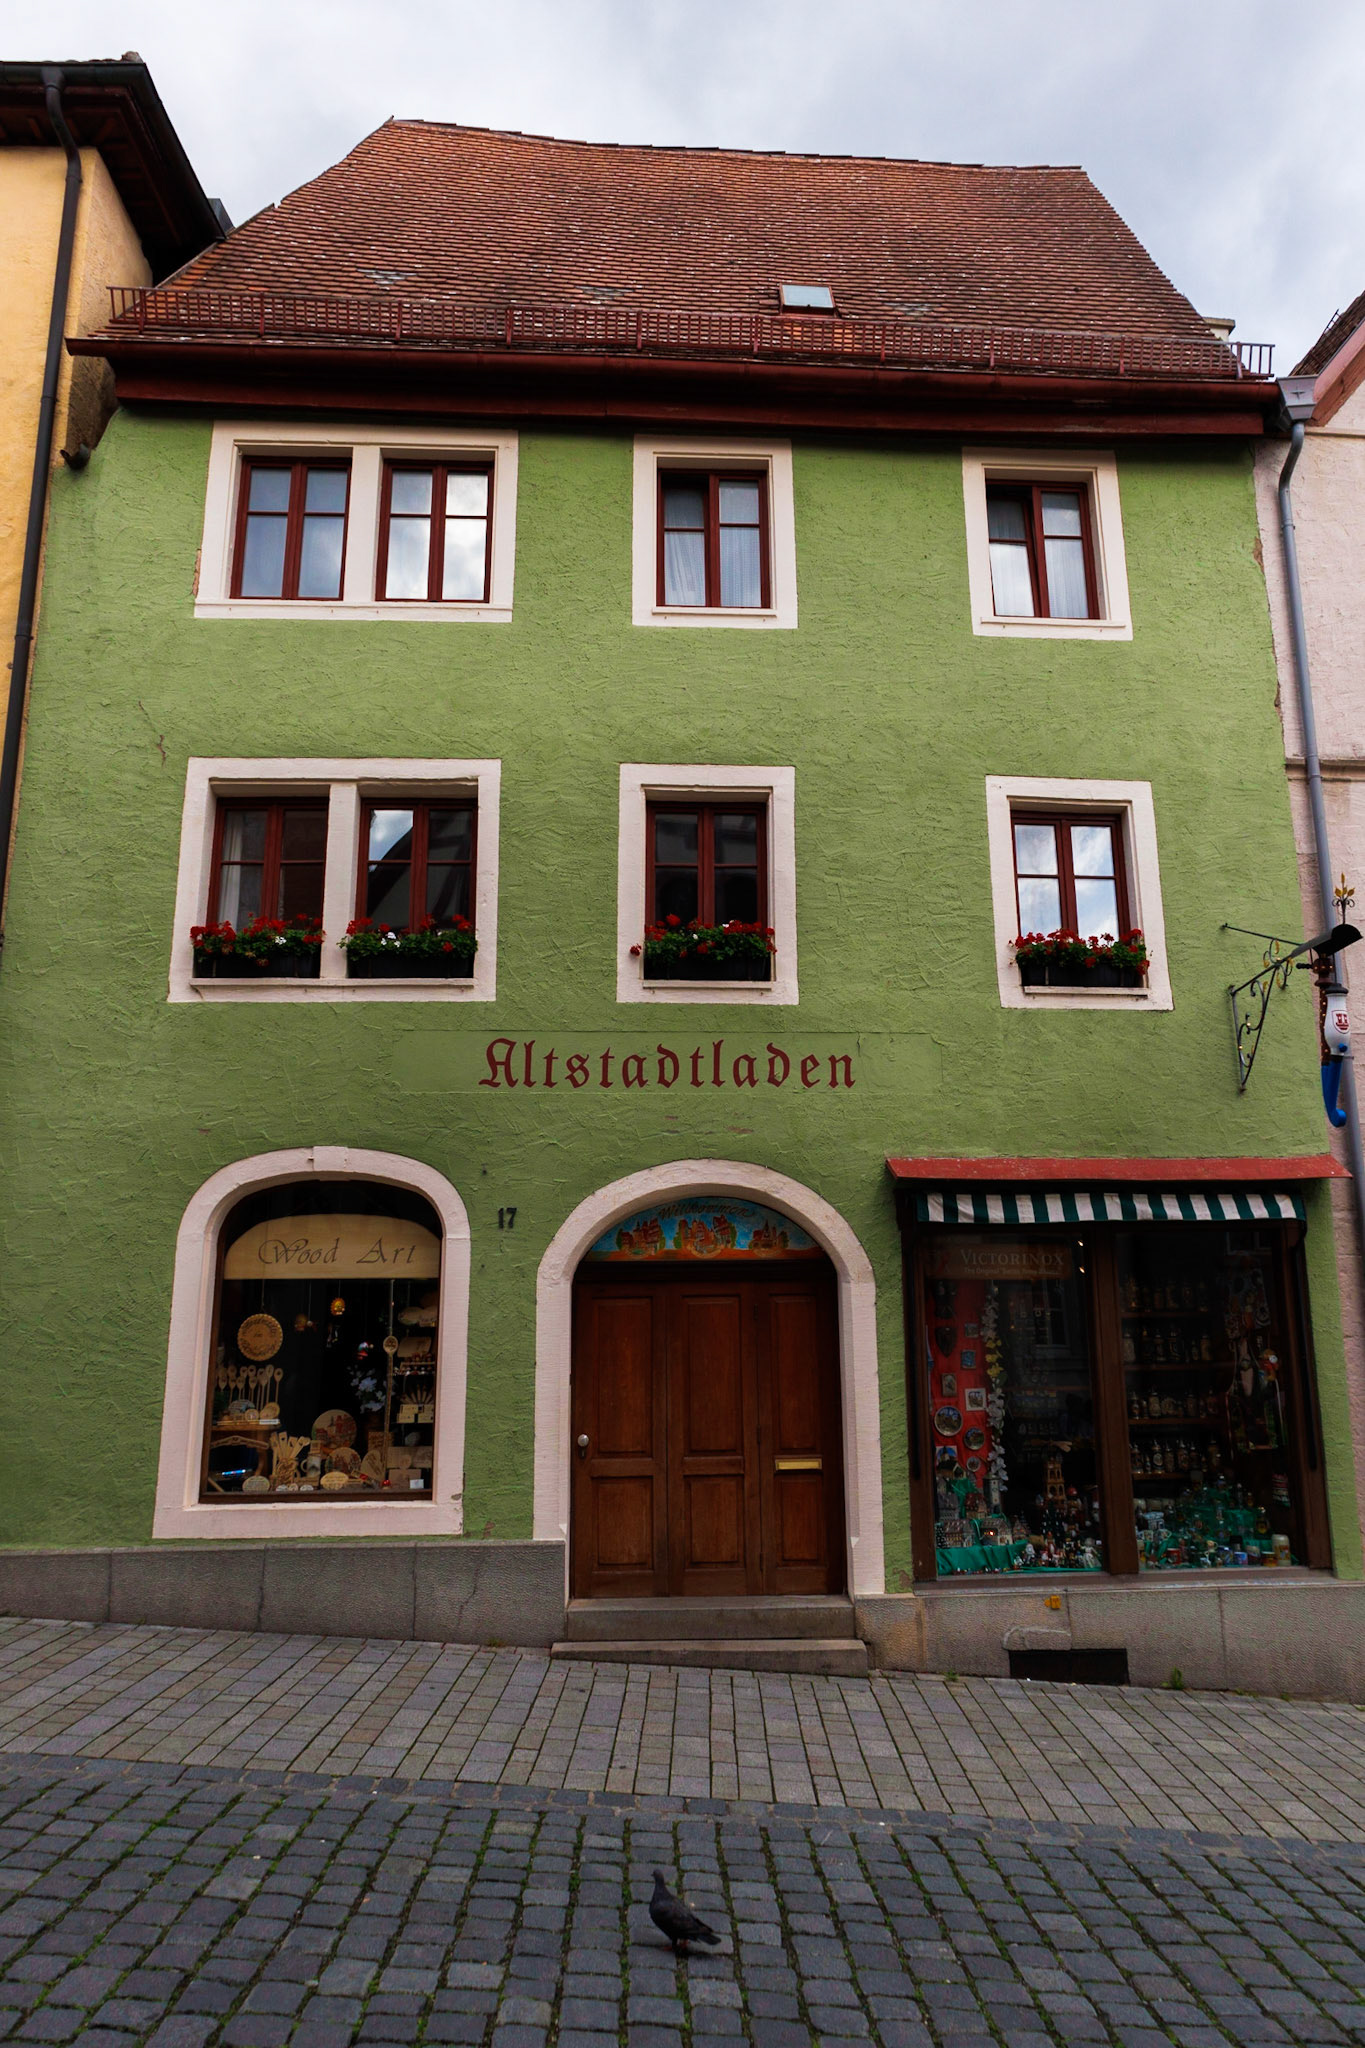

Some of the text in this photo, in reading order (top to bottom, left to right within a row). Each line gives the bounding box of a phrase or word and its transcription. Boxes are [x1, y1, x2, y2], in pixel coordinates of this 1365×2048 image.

[478, 1037, 856, 1089] Altstadtladen
[498, 1207, 518, 1229] 17
[258, 1235, 417, 1265] Wood Art
[960, 1249, 1064, 1266] VICTORINOX
